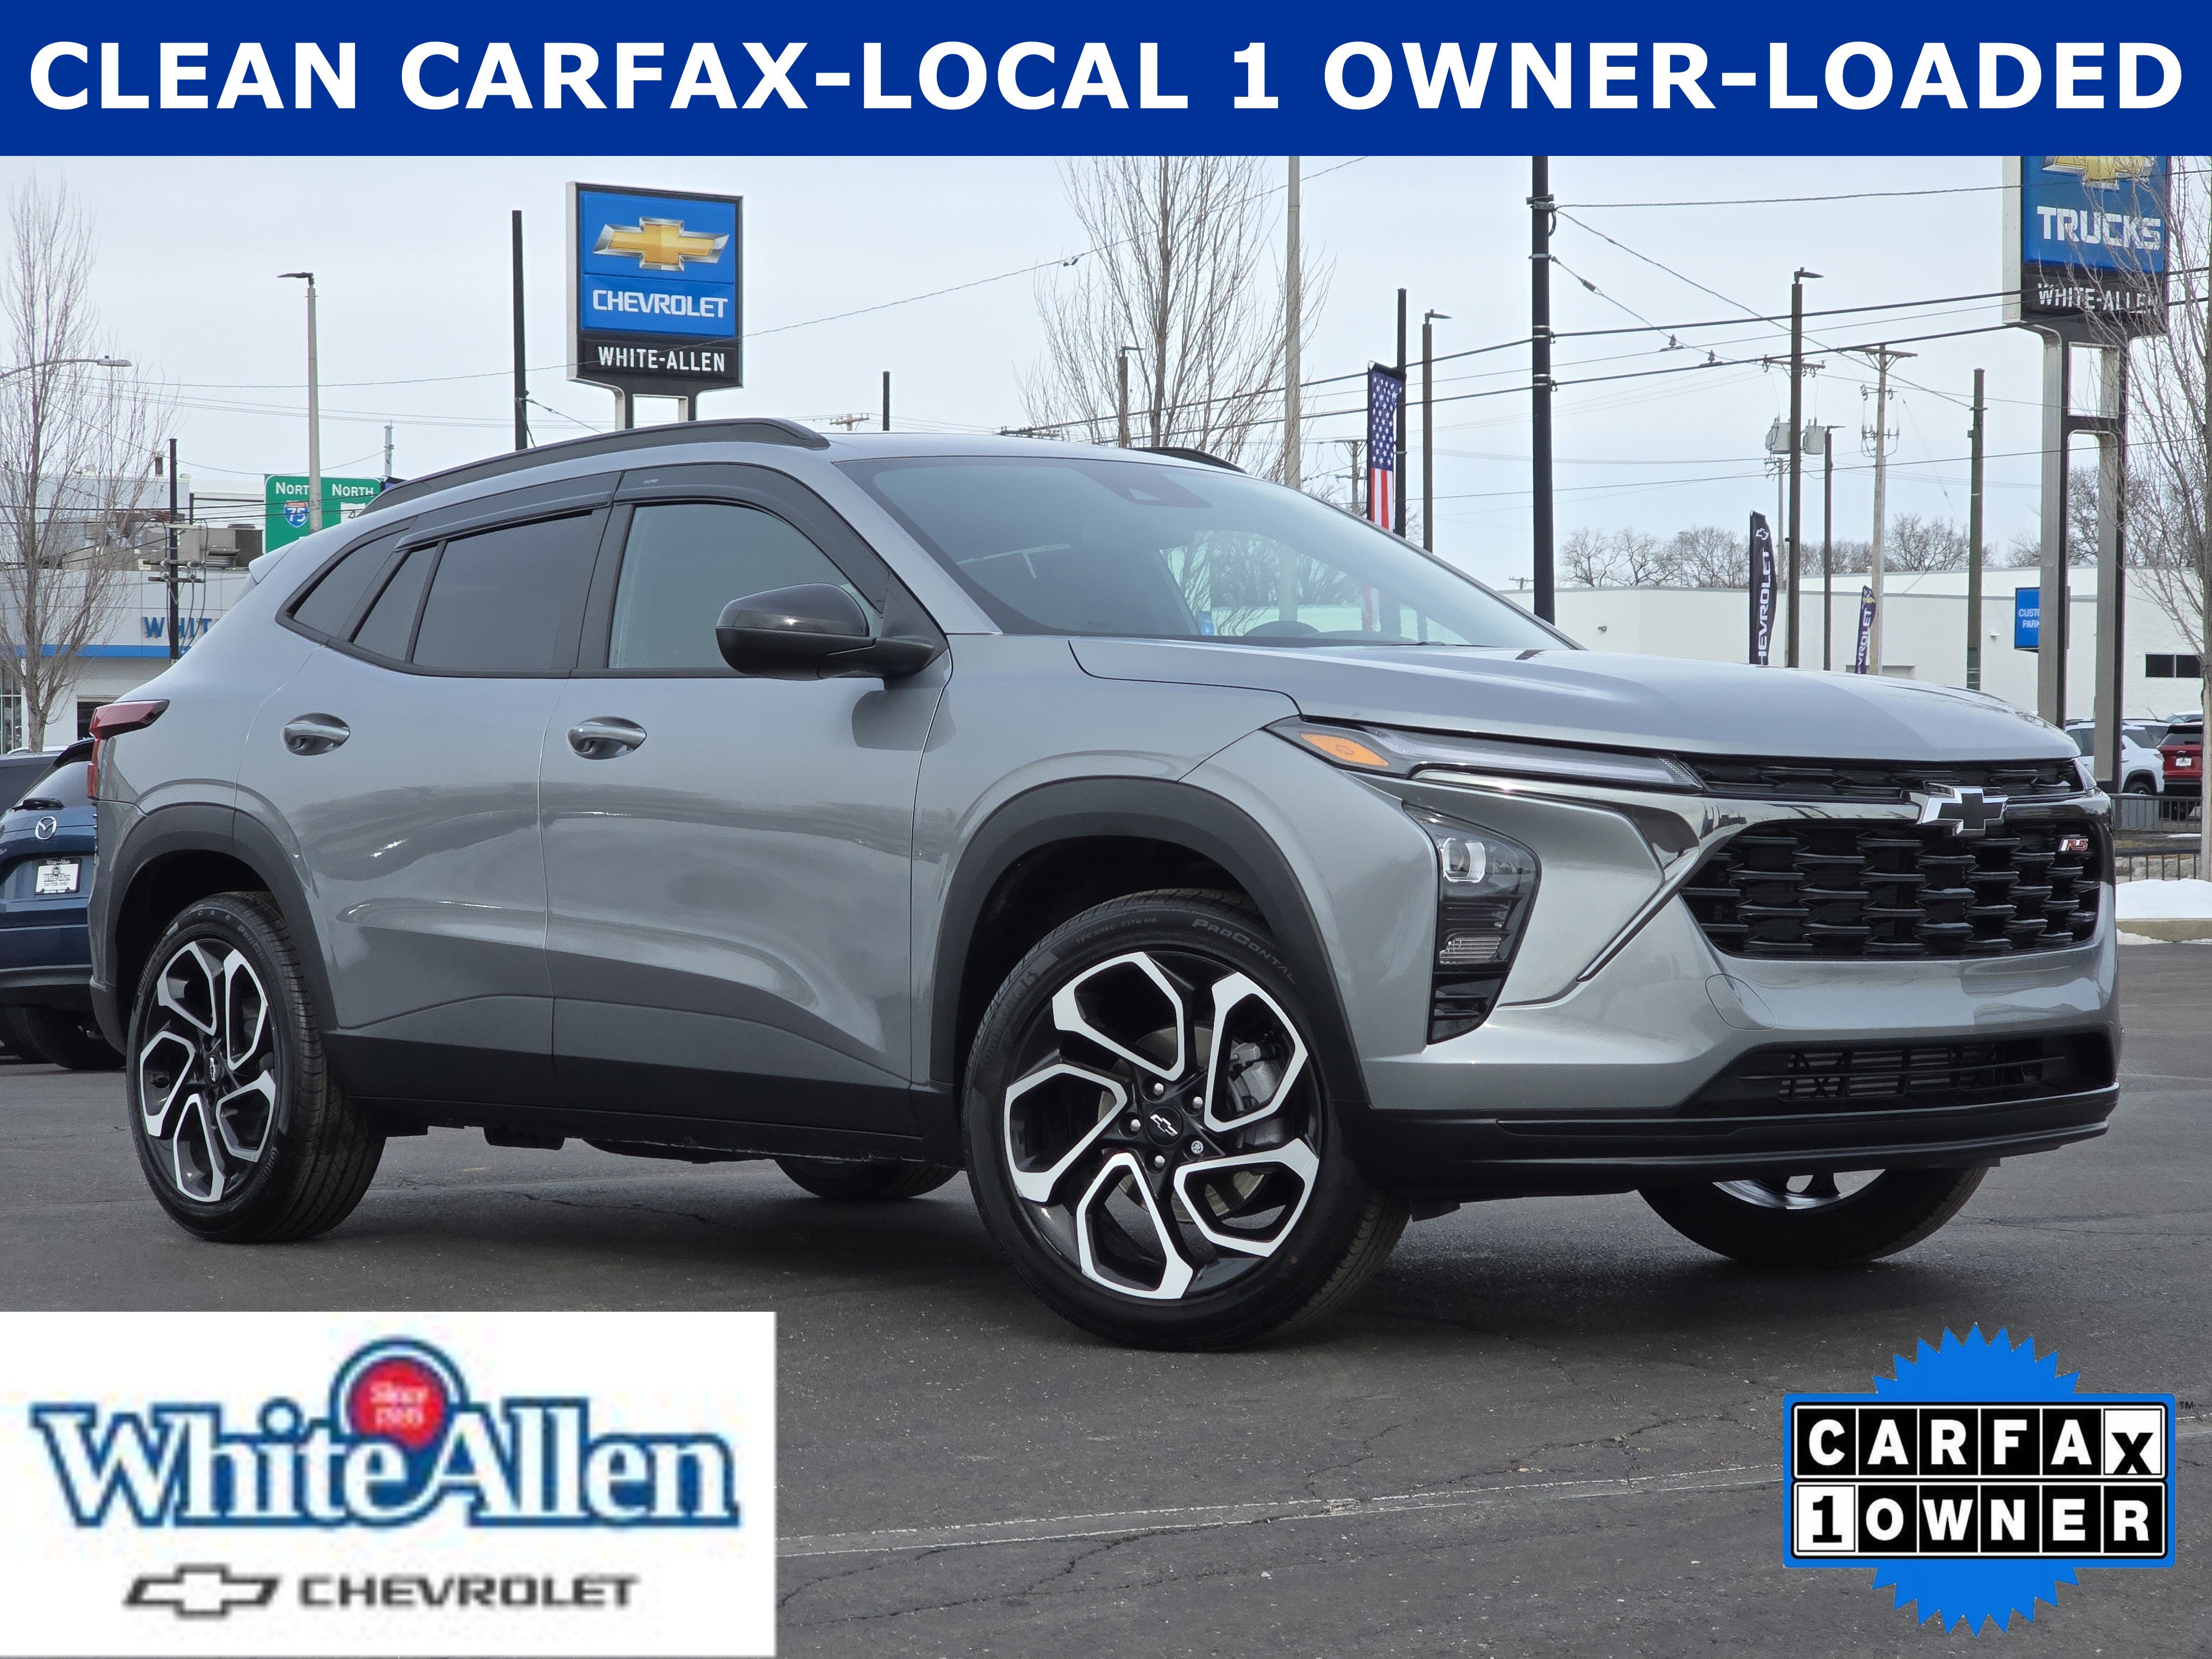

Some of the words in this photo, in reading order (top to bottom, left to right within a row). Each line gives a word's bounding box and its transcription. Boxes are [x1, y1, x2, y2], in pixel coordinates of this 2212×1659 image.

[2037, 206, 2161, 251] TRUCKS
[593, 289, 728, 318] CHEVROLET
[598, 346, 725, 372] WHITE-ALLEN
[275, 482, 310, 495] NORT
[332, 484, 374, 497] NORTH
[287, 508, 306, 522] 75
[1758, 547, 1771, 665] HEVROLET
[2060, 838, 2089, 851] RS
